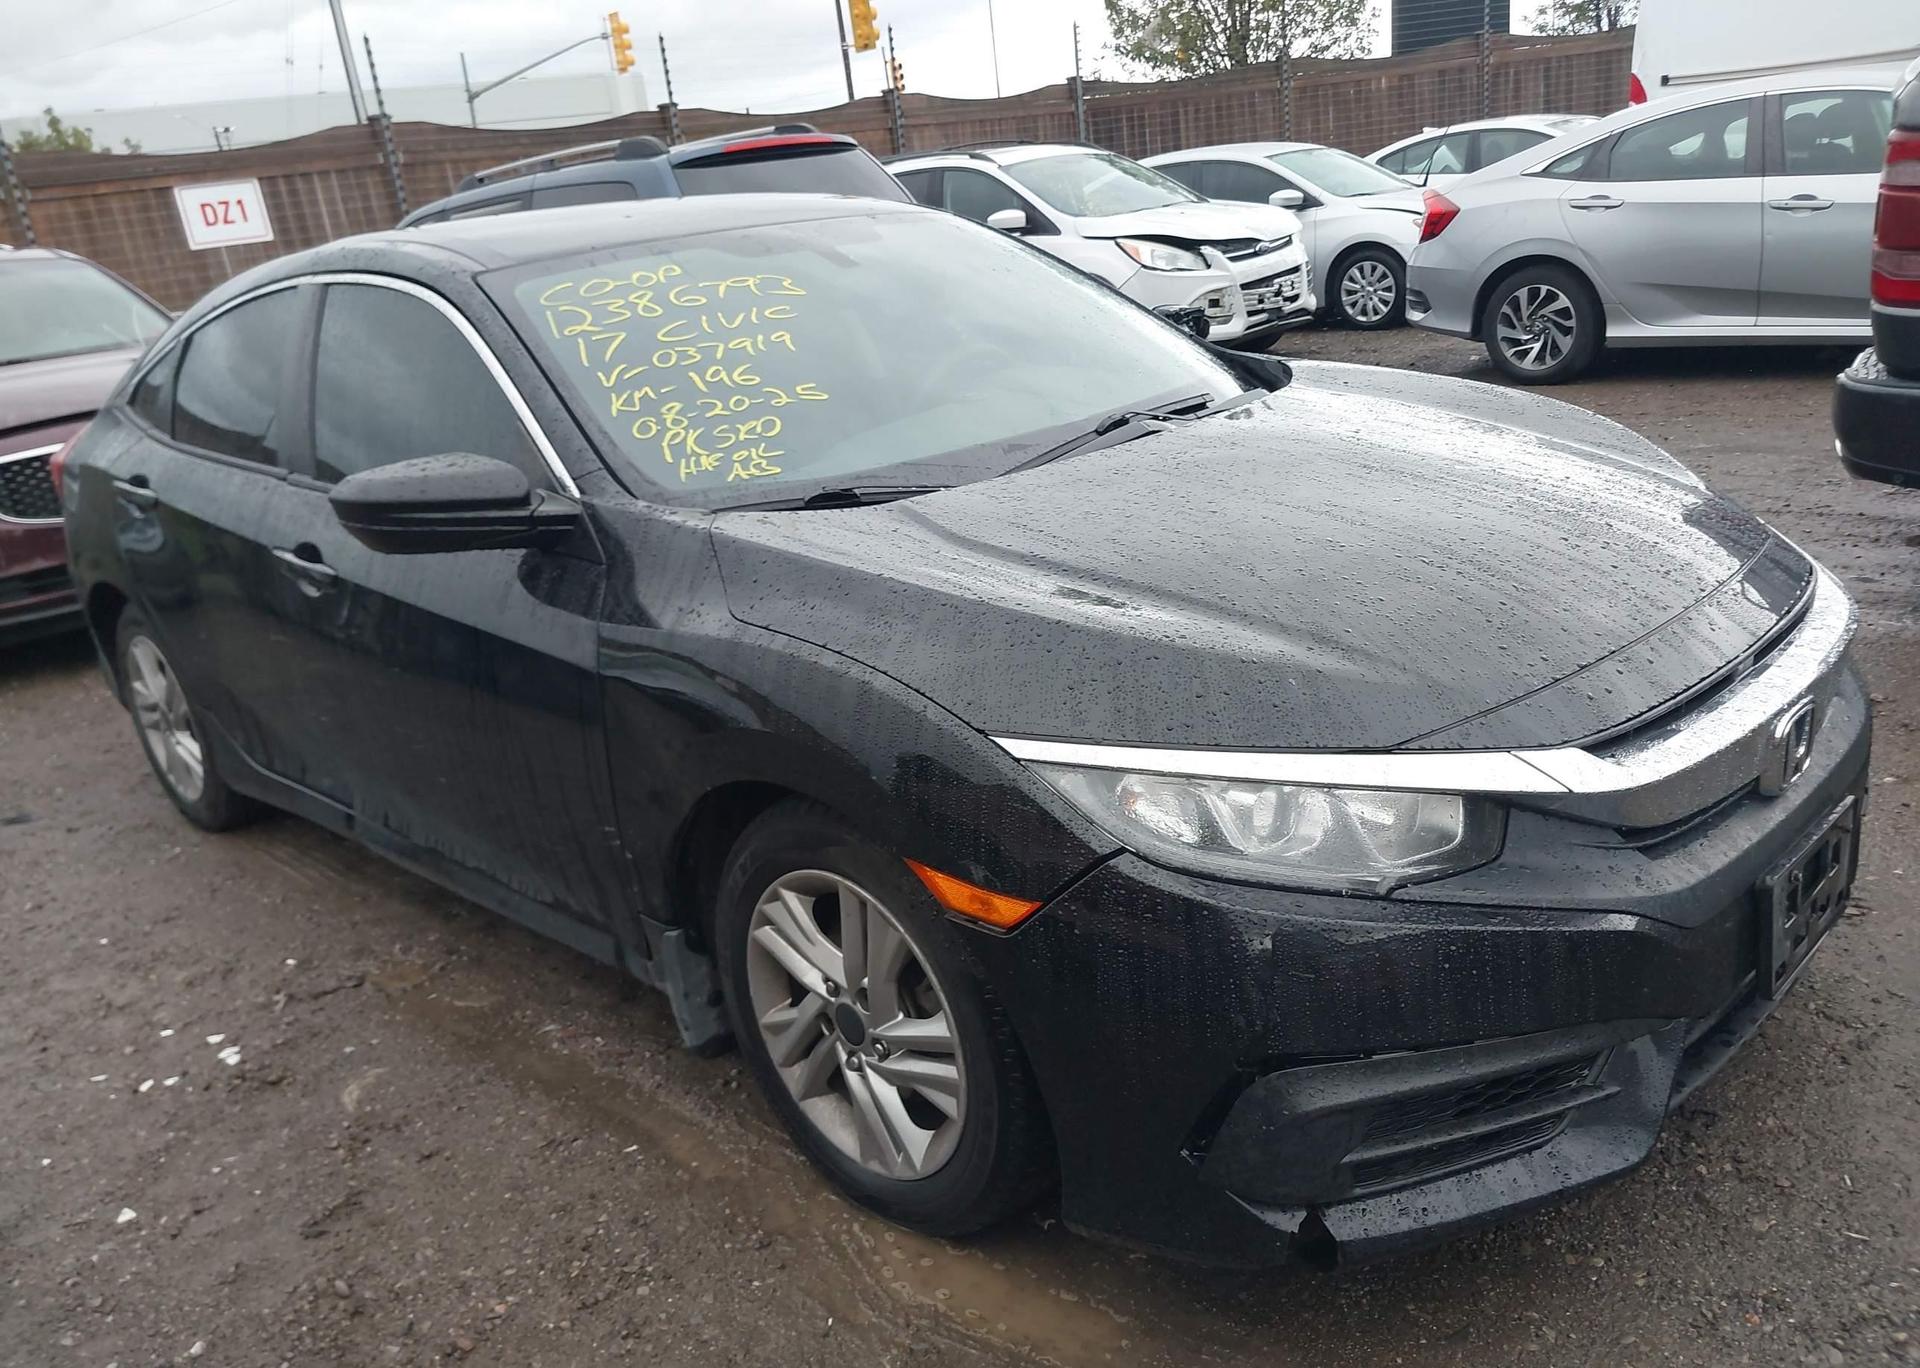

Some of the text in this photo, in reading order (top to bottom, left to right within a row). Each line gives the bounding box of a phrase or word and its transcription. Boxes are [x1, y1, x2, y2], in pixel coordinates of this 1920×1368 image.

[199, 199, 249, 227] DZ1
[544, 275, 807, 338] 12386793
[578, 306, 799, 367] 17 CIVIC
